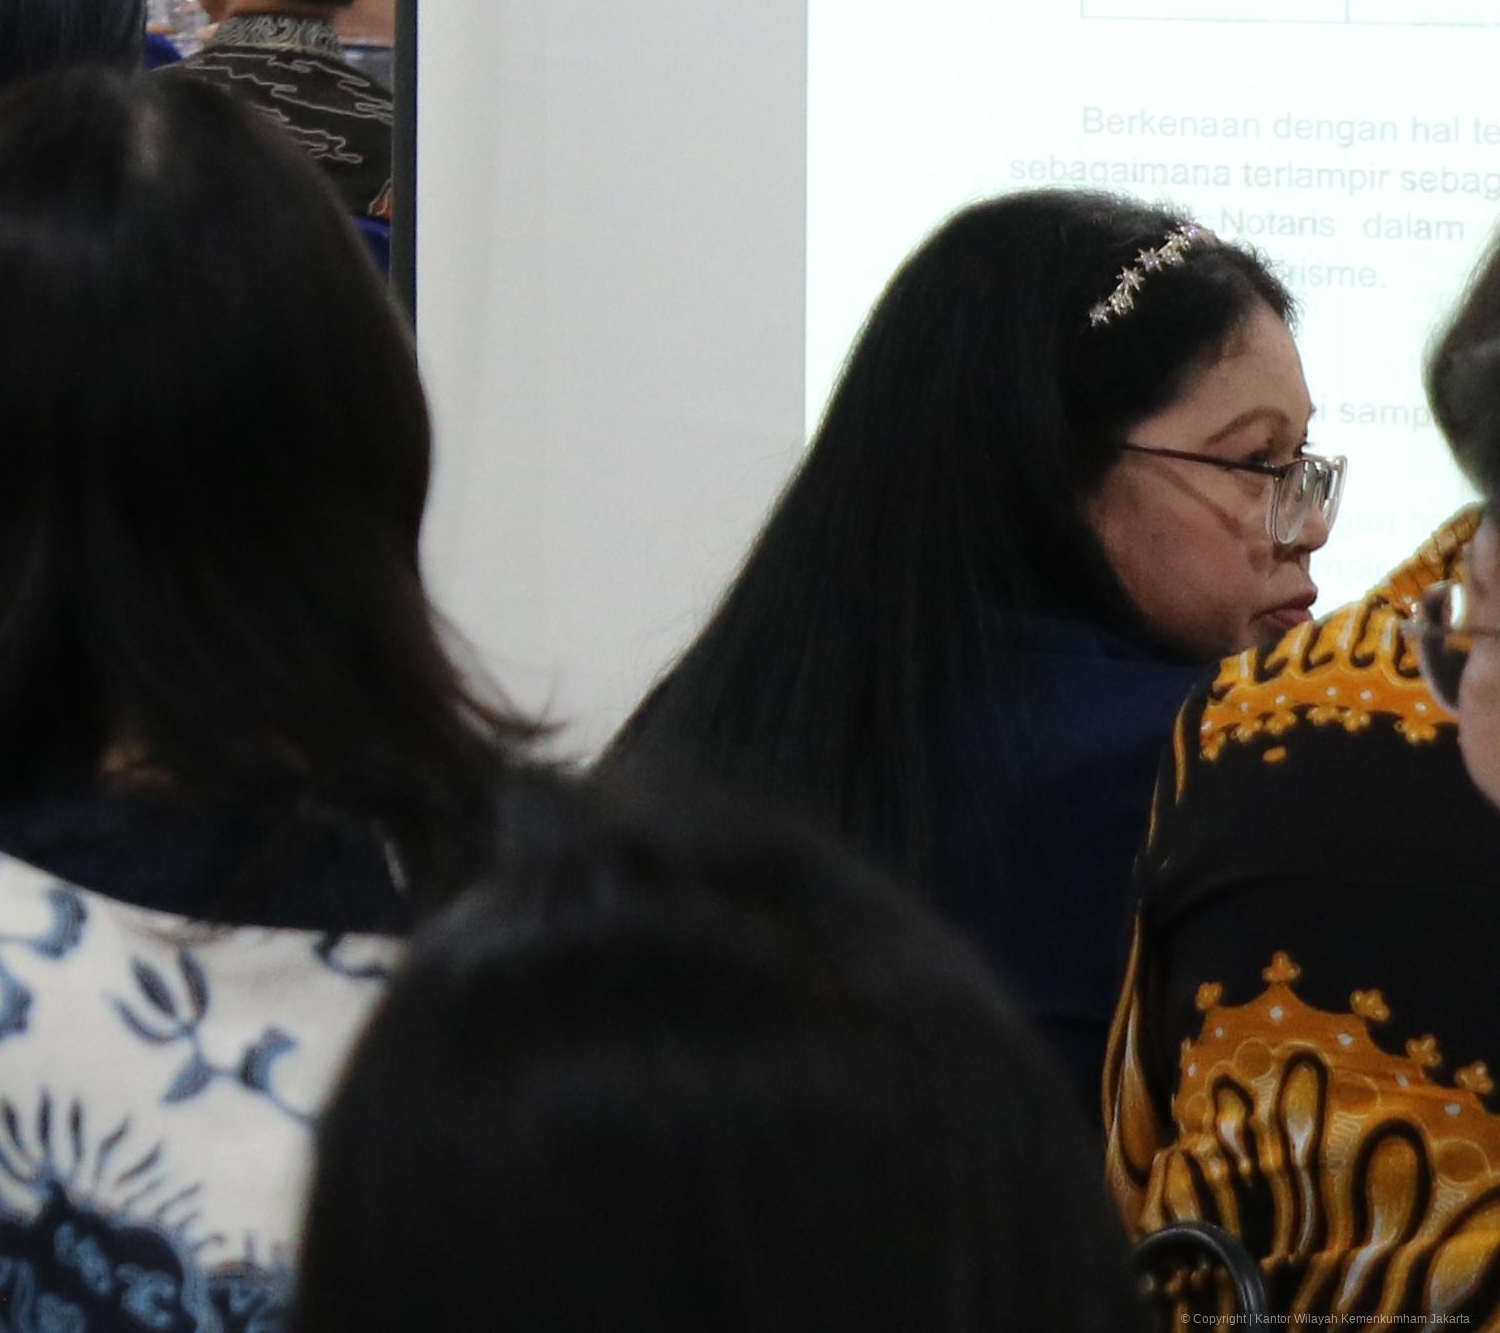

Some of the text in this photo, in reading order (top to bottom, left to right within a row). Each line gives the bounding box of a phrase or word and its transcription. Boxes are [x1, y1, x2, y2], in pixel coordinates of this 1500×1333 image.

[1083, 107, 1459, 148] Berkenaan dengan hal
[1010, 155, 1230, 189] sebagaimana
[1243, 161, 1389, 195] terlampir
[1221, 209, 1464, 241] Notaris dalam
